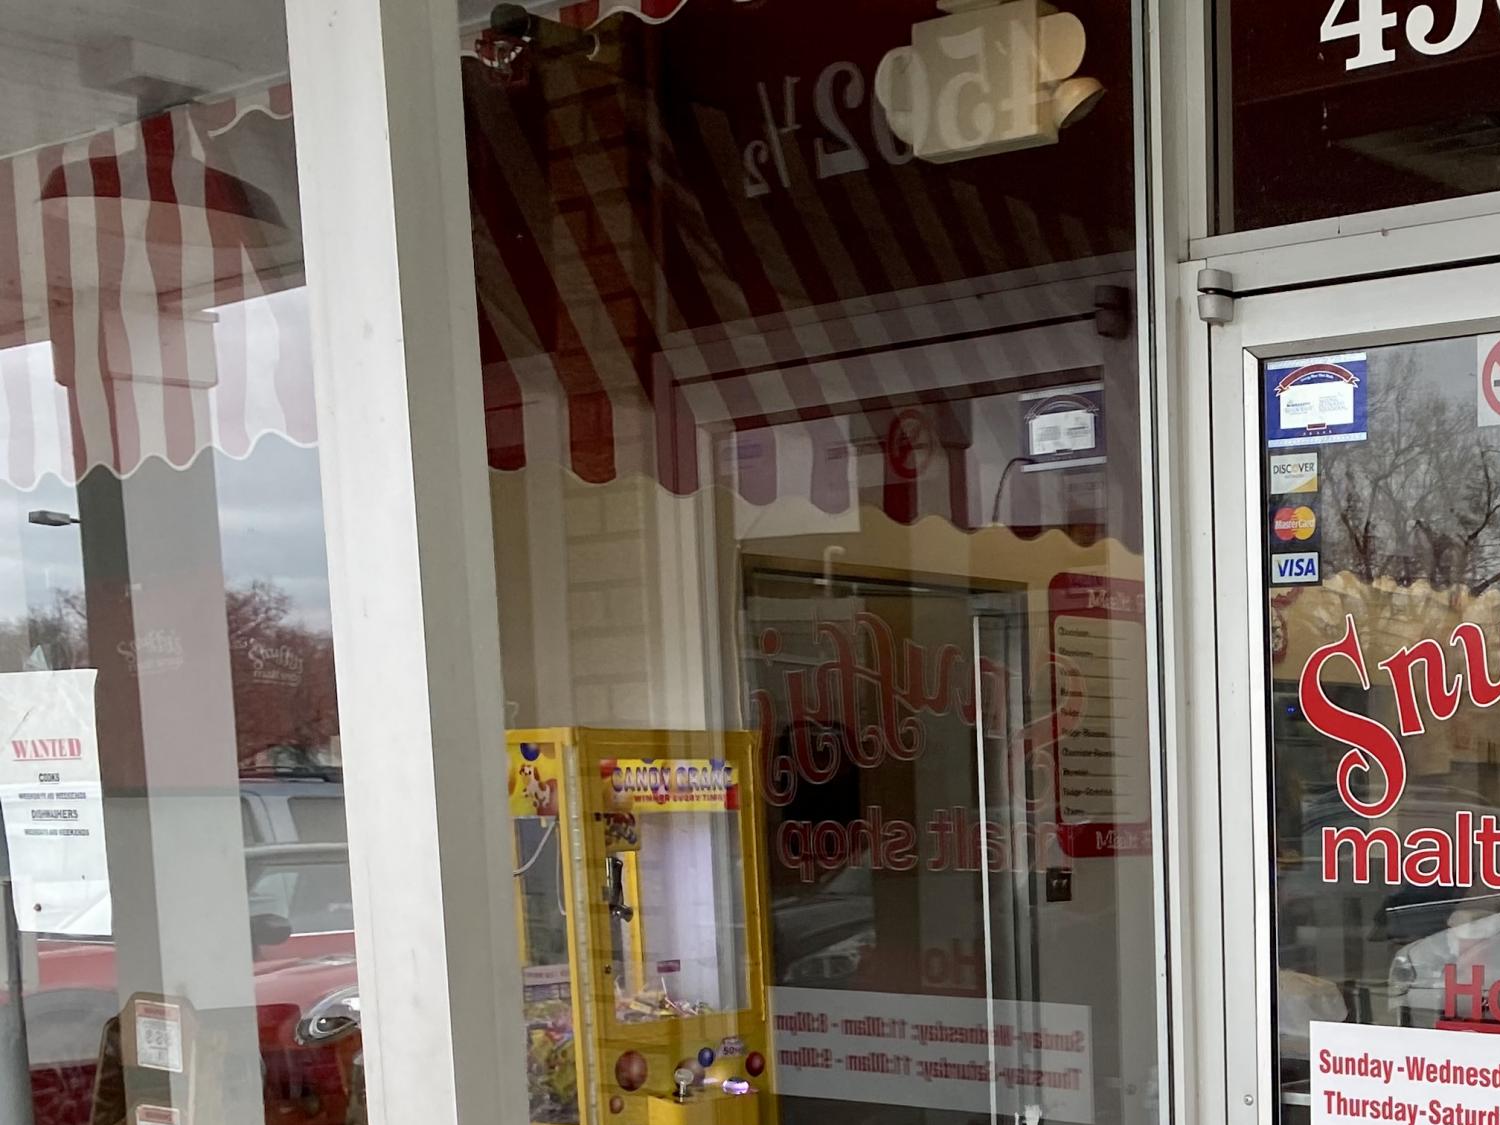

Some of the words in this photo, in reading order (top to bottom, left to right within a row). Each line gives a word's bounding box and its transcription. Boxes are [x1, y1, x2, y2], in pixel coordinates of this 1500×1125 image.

[1273, 462, 1315, 475] DISCOVER
[1275, 519, 1316, 531] MasterCard
[1278, 558, 1316, 577] VISA
[12, 738, 81, 758] WANTED
[39, 773, 60, 782] COOKS
[611, 766, 671, 792] CANDY
[675, 766, 734, 792] CRANE
[31, 809, 78, 819] DISHWASHERS
